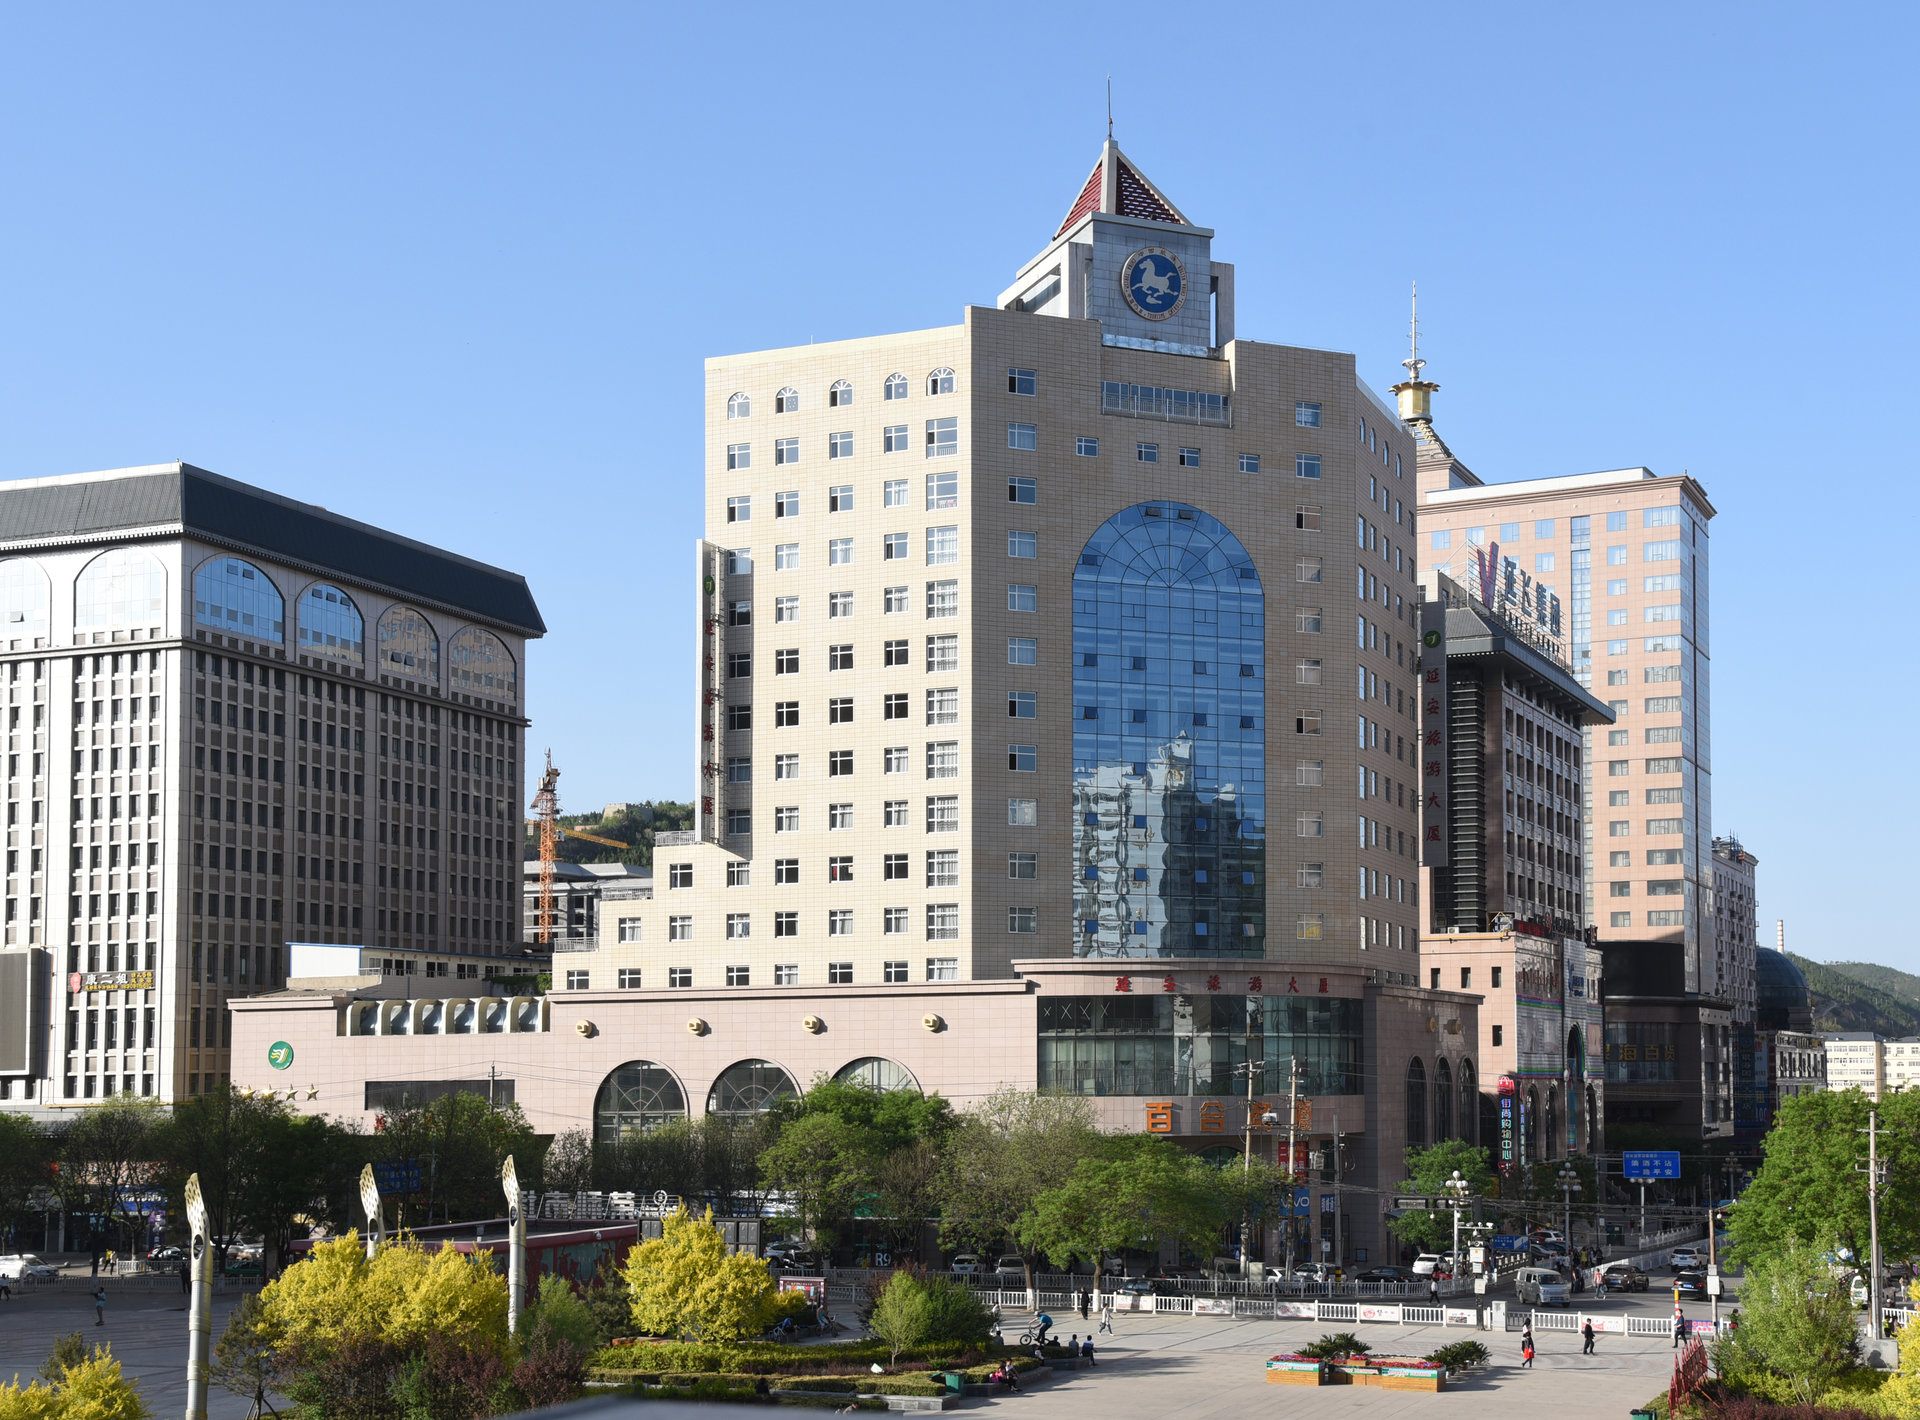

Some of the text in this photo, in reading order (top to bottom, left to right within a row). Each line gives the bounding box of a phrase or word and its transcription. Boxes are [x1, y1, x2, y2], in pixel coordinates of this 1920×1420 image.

[1425, 668, 1442, 841] 延安旅游大厦
[1115, 974, 1329, 994] 延安旅游大厦
